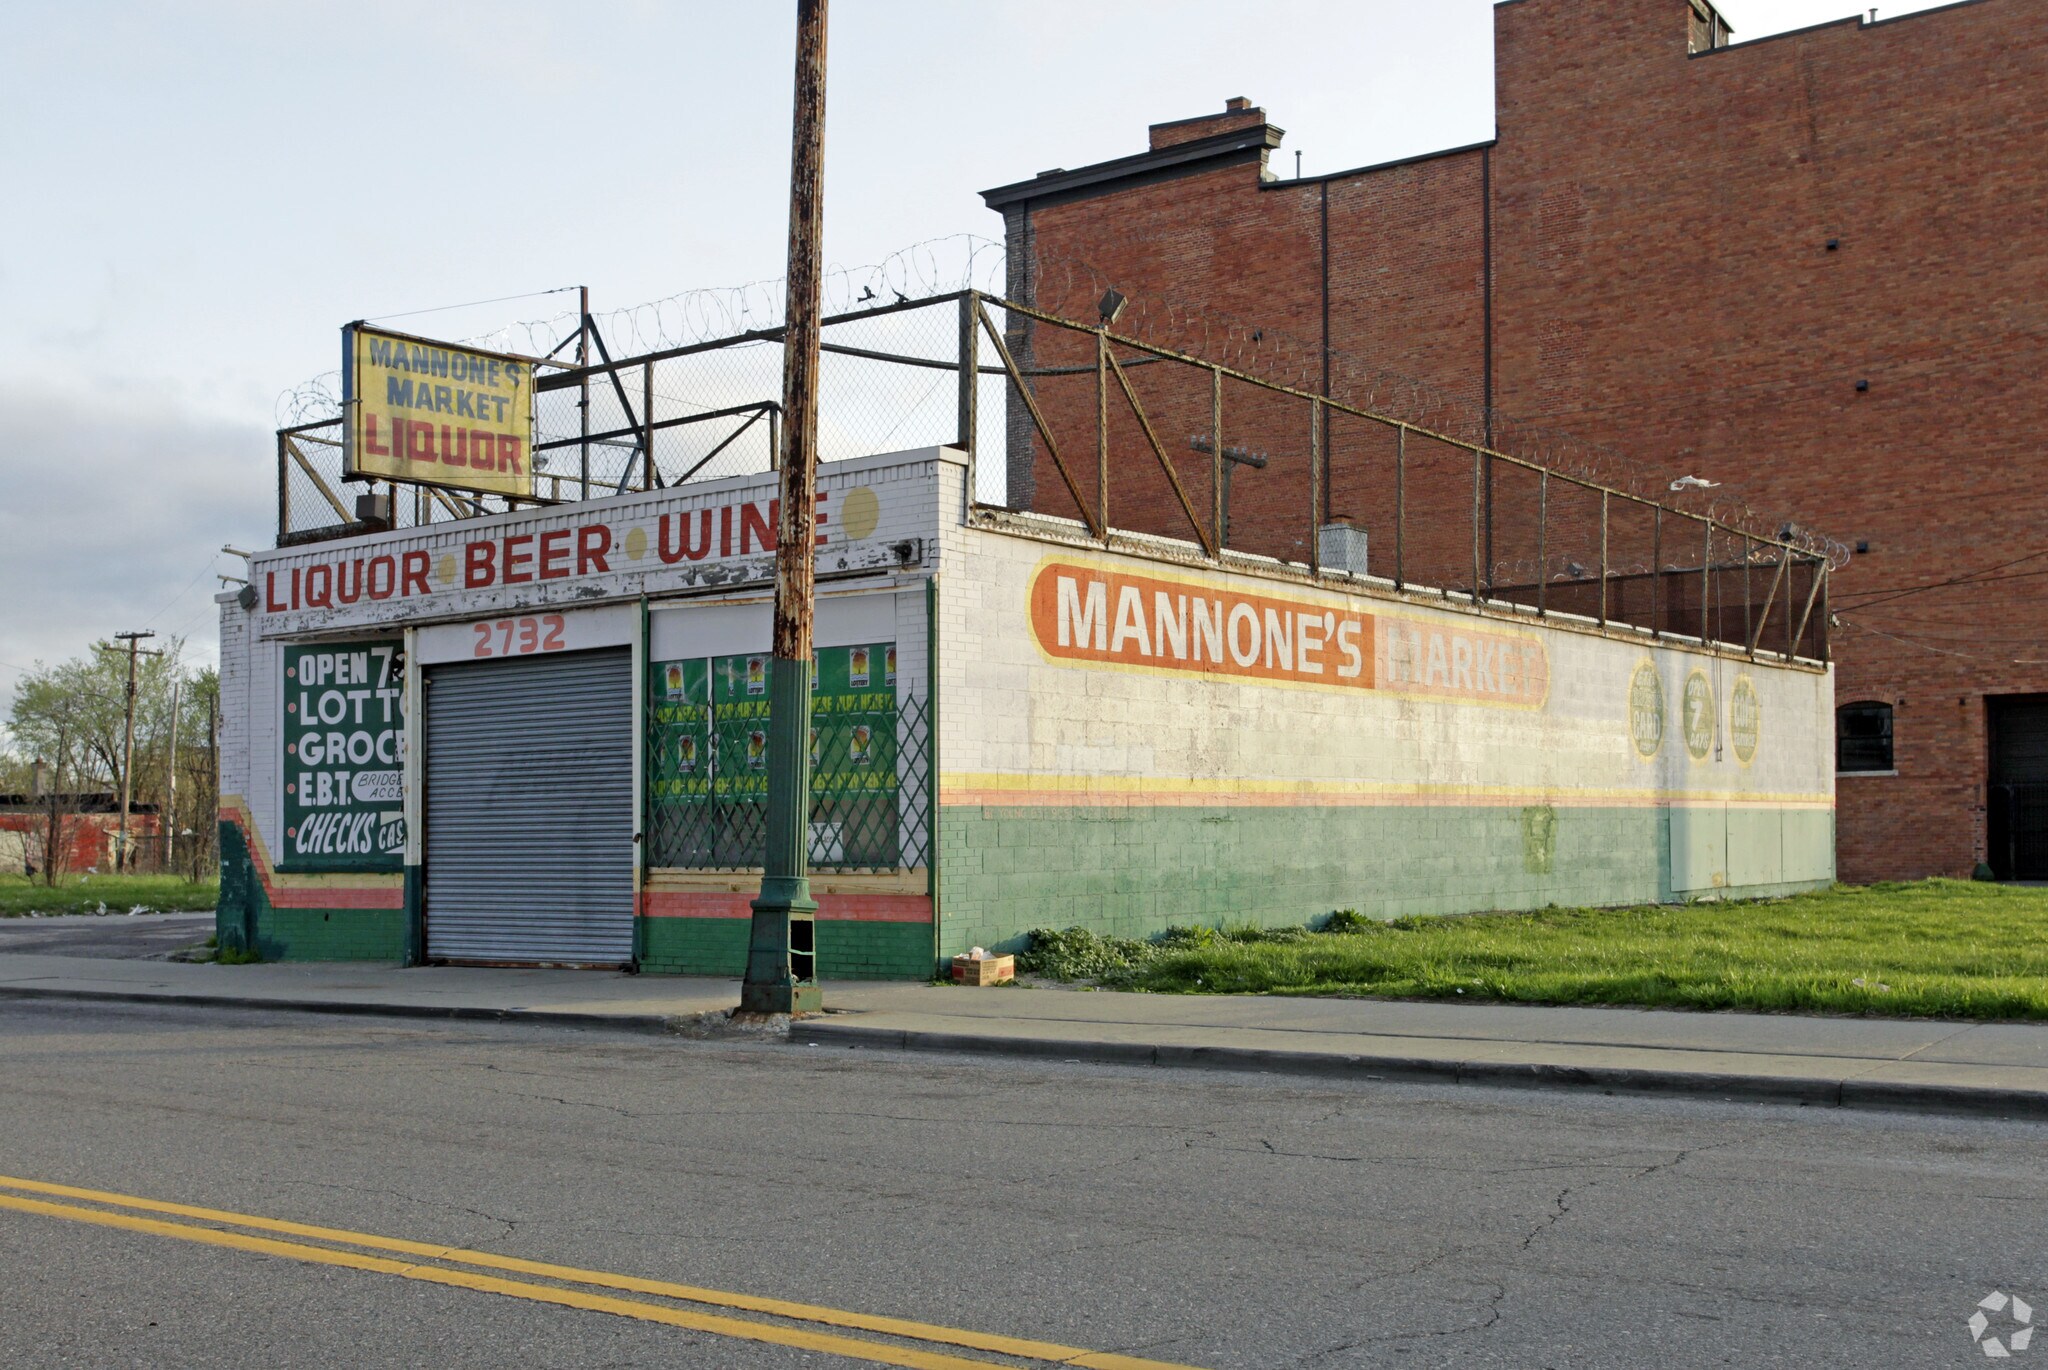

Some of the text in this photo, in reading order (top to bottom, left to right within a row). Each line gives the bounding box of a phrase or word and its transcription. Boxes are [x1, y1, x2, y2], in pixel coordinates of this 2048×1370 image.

[386, 376, 510, 423] MARKET
[366, 413, 523, 475] LIQUOR
[266, 550, 432, 613] LIQUOR
[464, 524, 611, 589] BEER
[473, 614, 566, 657] 2732
[1057, 576, 1536, 697] MANNONE'S MARKET
[298, 652, 368, 686] OPEN
[300, 688, 405, 726] LOTT
[1690, 700, 1703, 731] 7
[299, 771, 352, 806] E.B.T.
[296, 812, 377, 854] CHECKS
